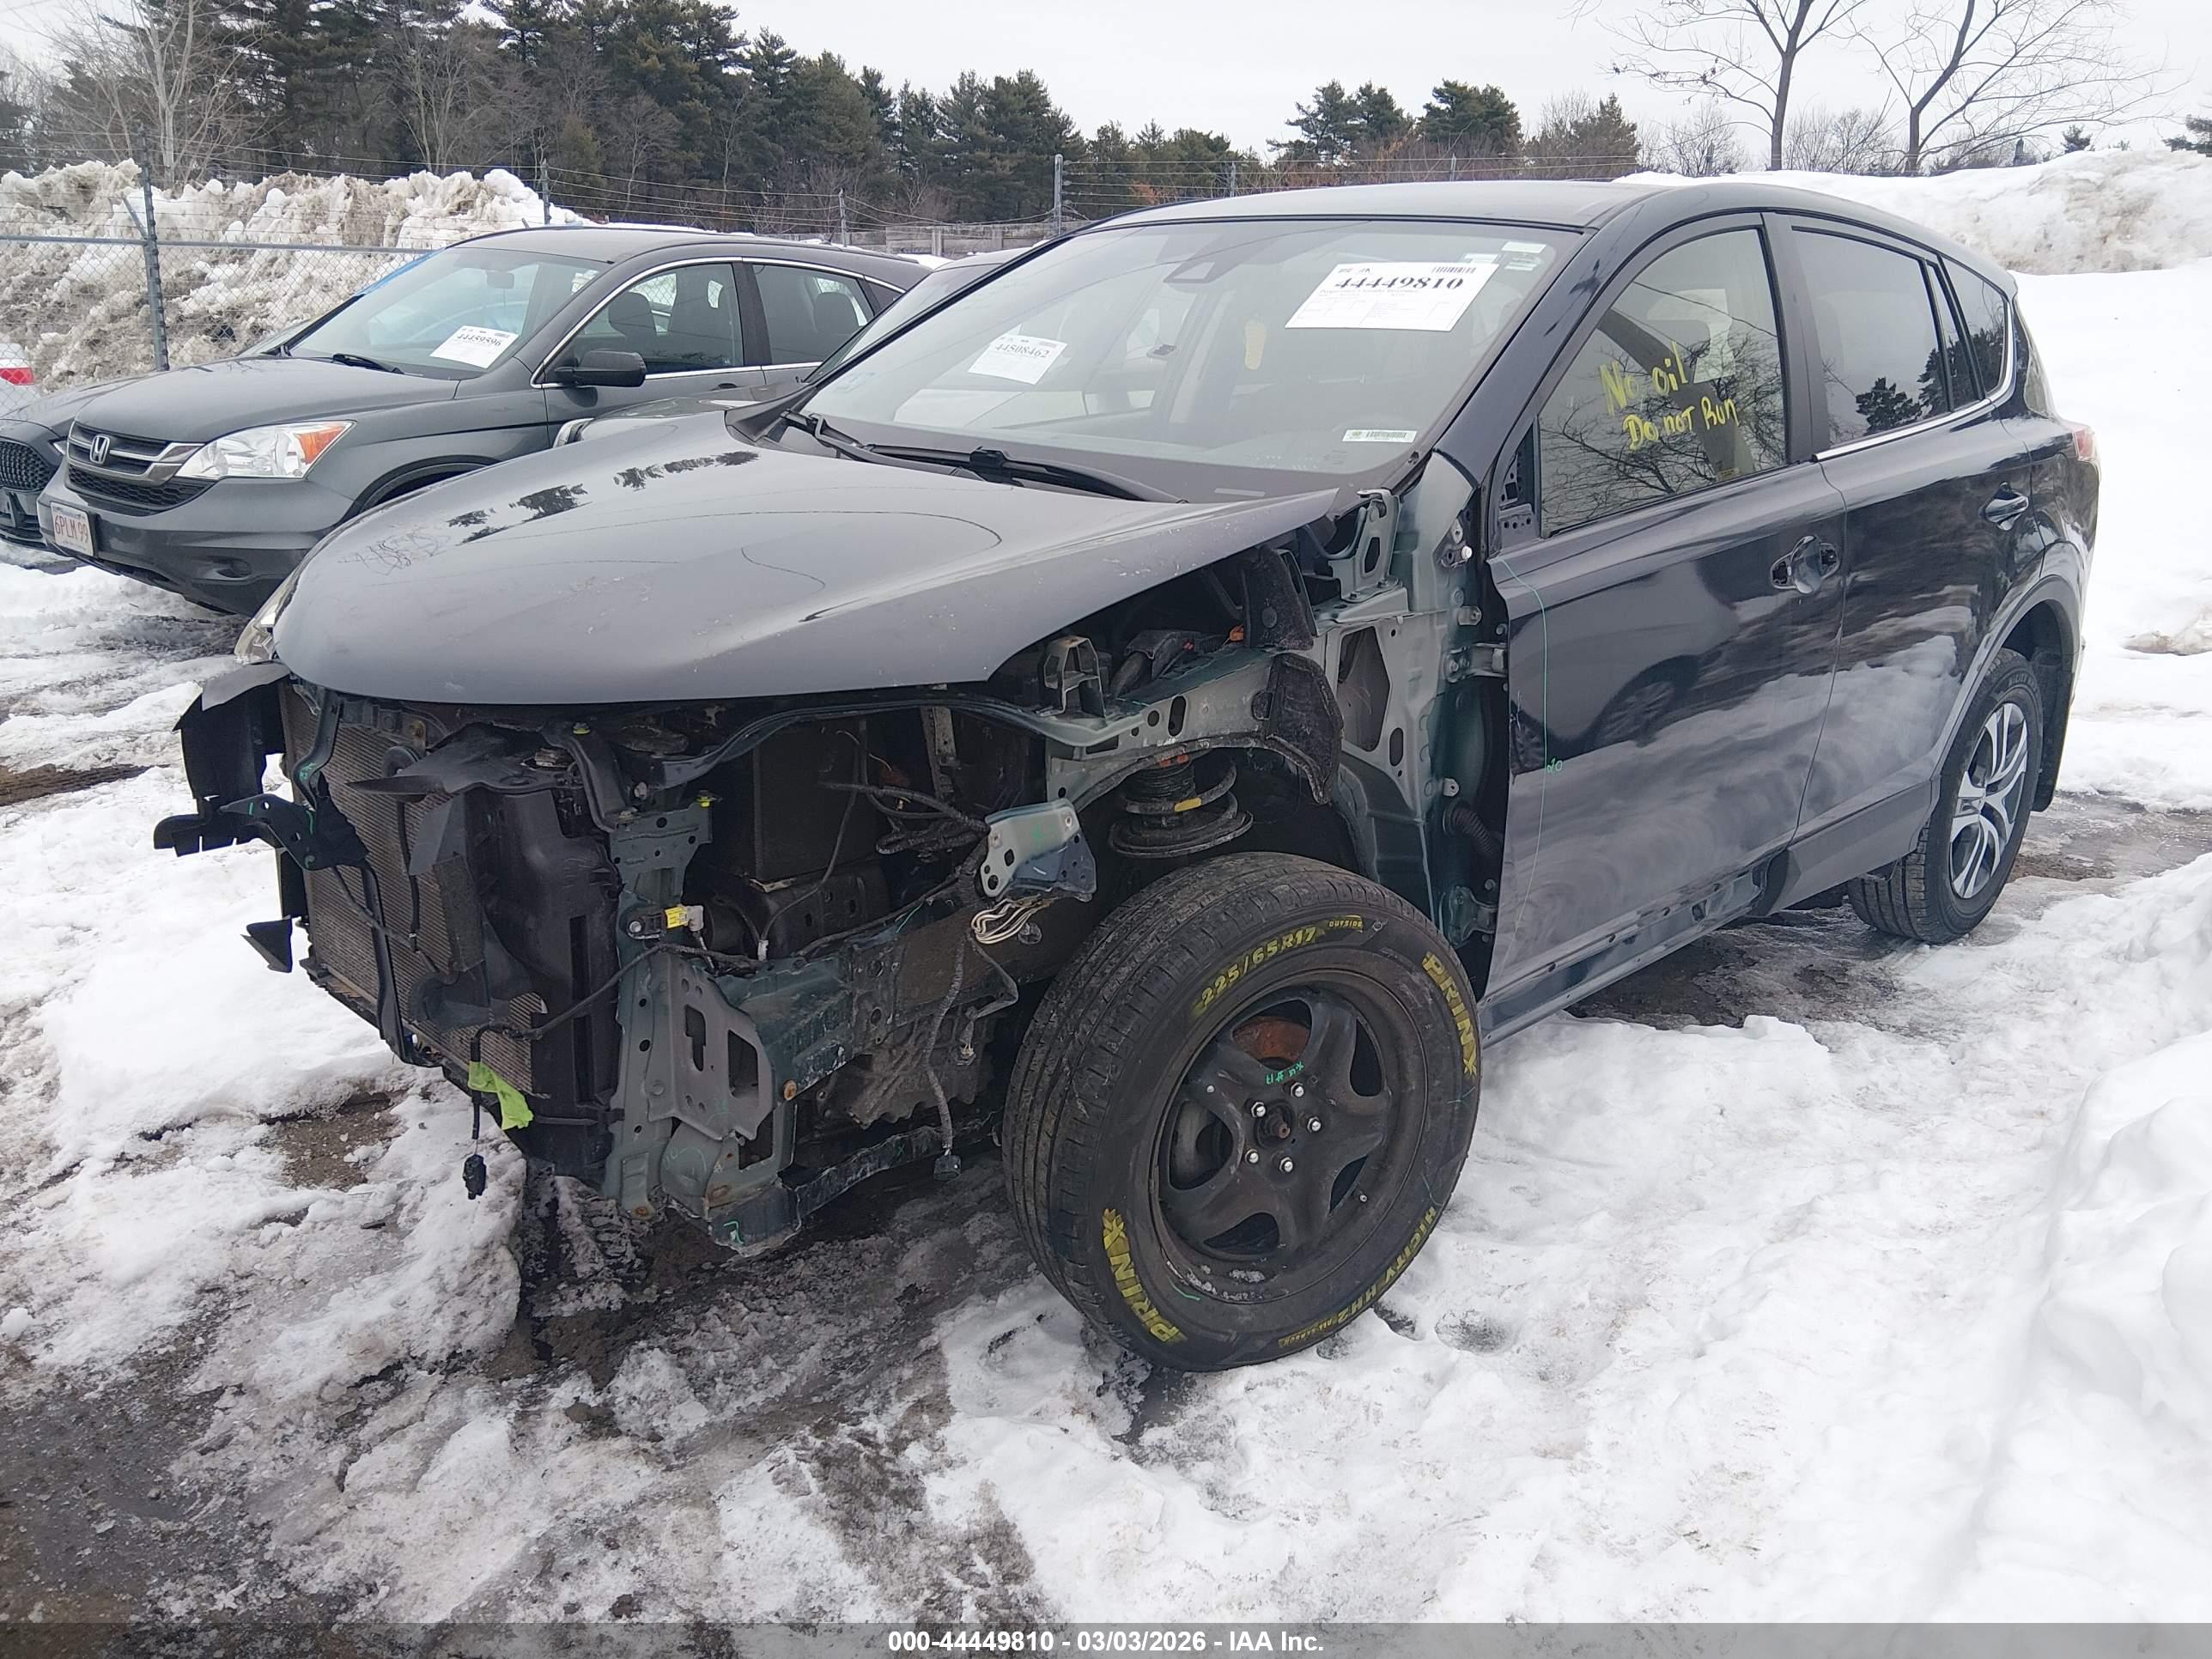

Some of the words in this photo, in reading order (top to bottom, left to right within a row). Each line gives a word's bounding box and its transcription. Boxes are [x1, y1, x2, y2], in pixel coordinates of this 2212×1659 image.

[1335, 276, 1465, 289] 44449810
[1598, 360, 1639, 416] No
[1623, 414, 1659, 451] Do
